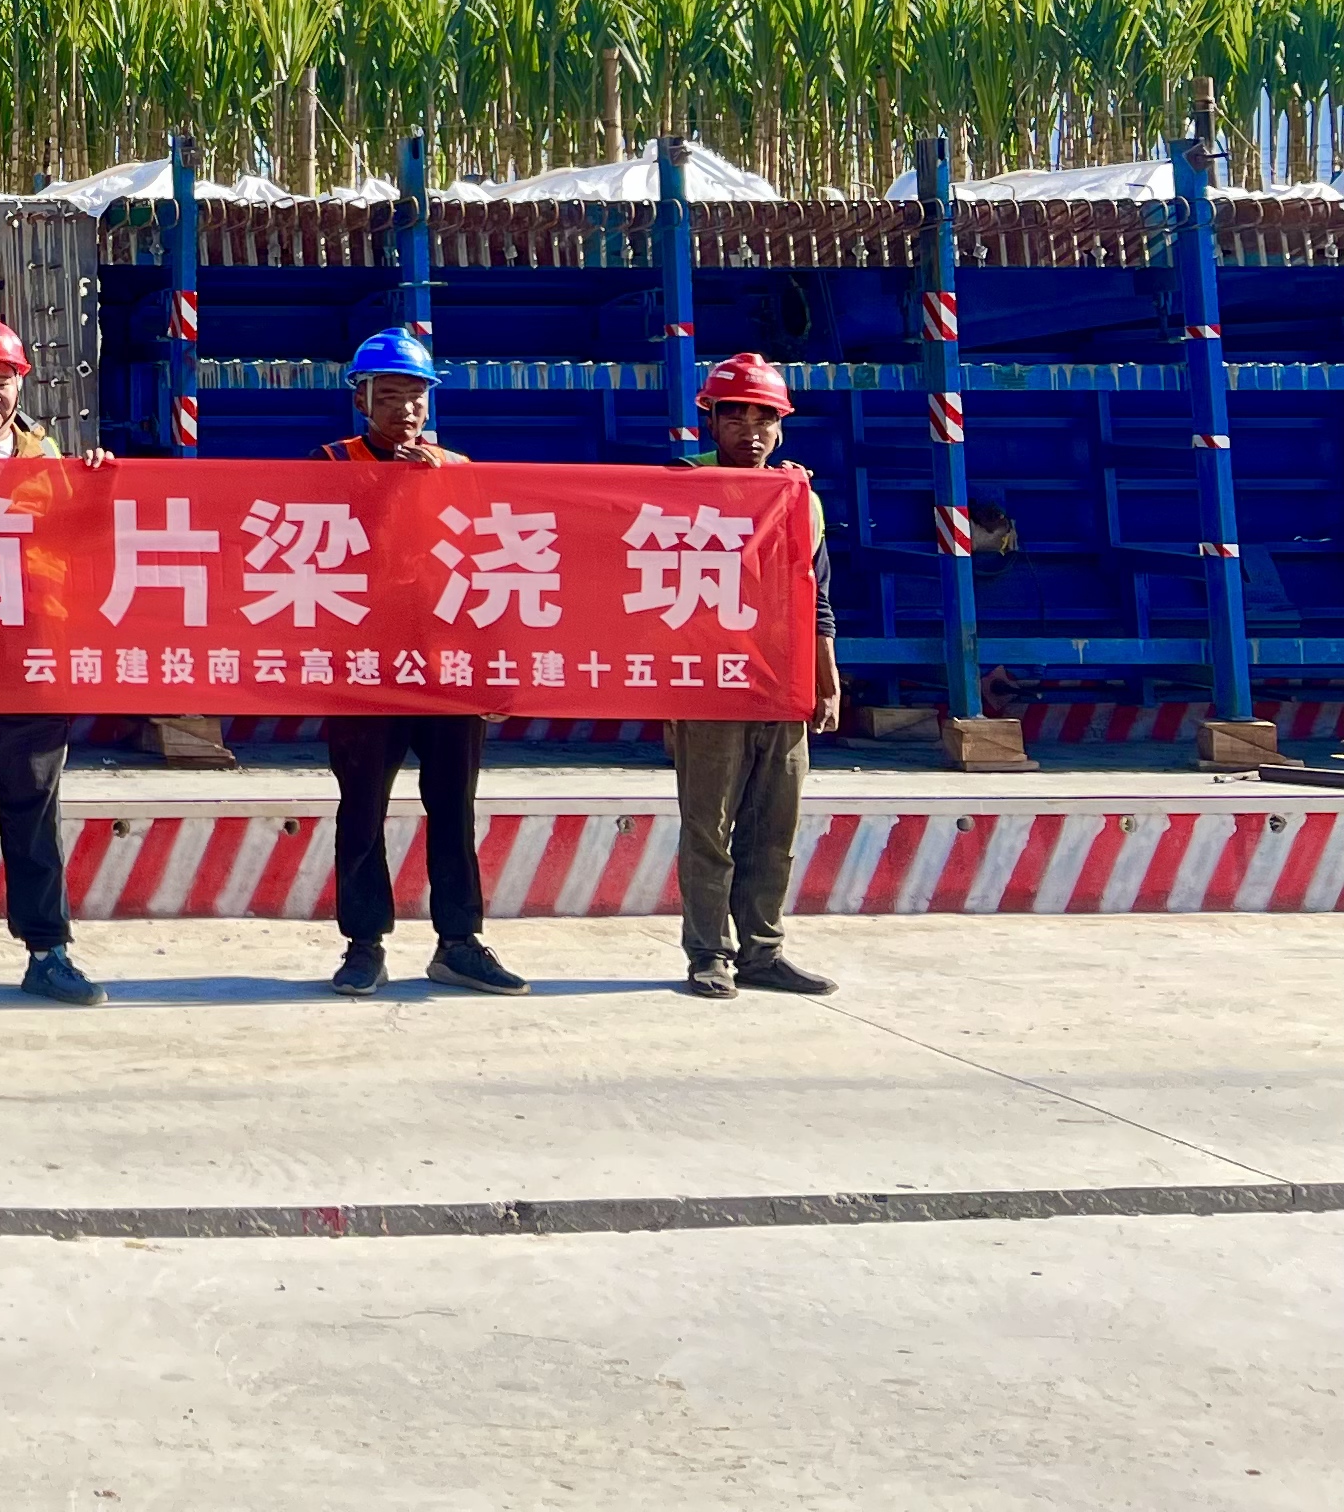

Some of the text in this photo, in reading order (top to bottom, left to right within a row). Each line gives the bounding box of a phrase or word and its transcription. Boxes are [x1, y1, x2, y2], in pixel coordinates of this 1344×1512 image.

[23, 646, 750, 688] 云南建投南云高速公路土建十五工区
